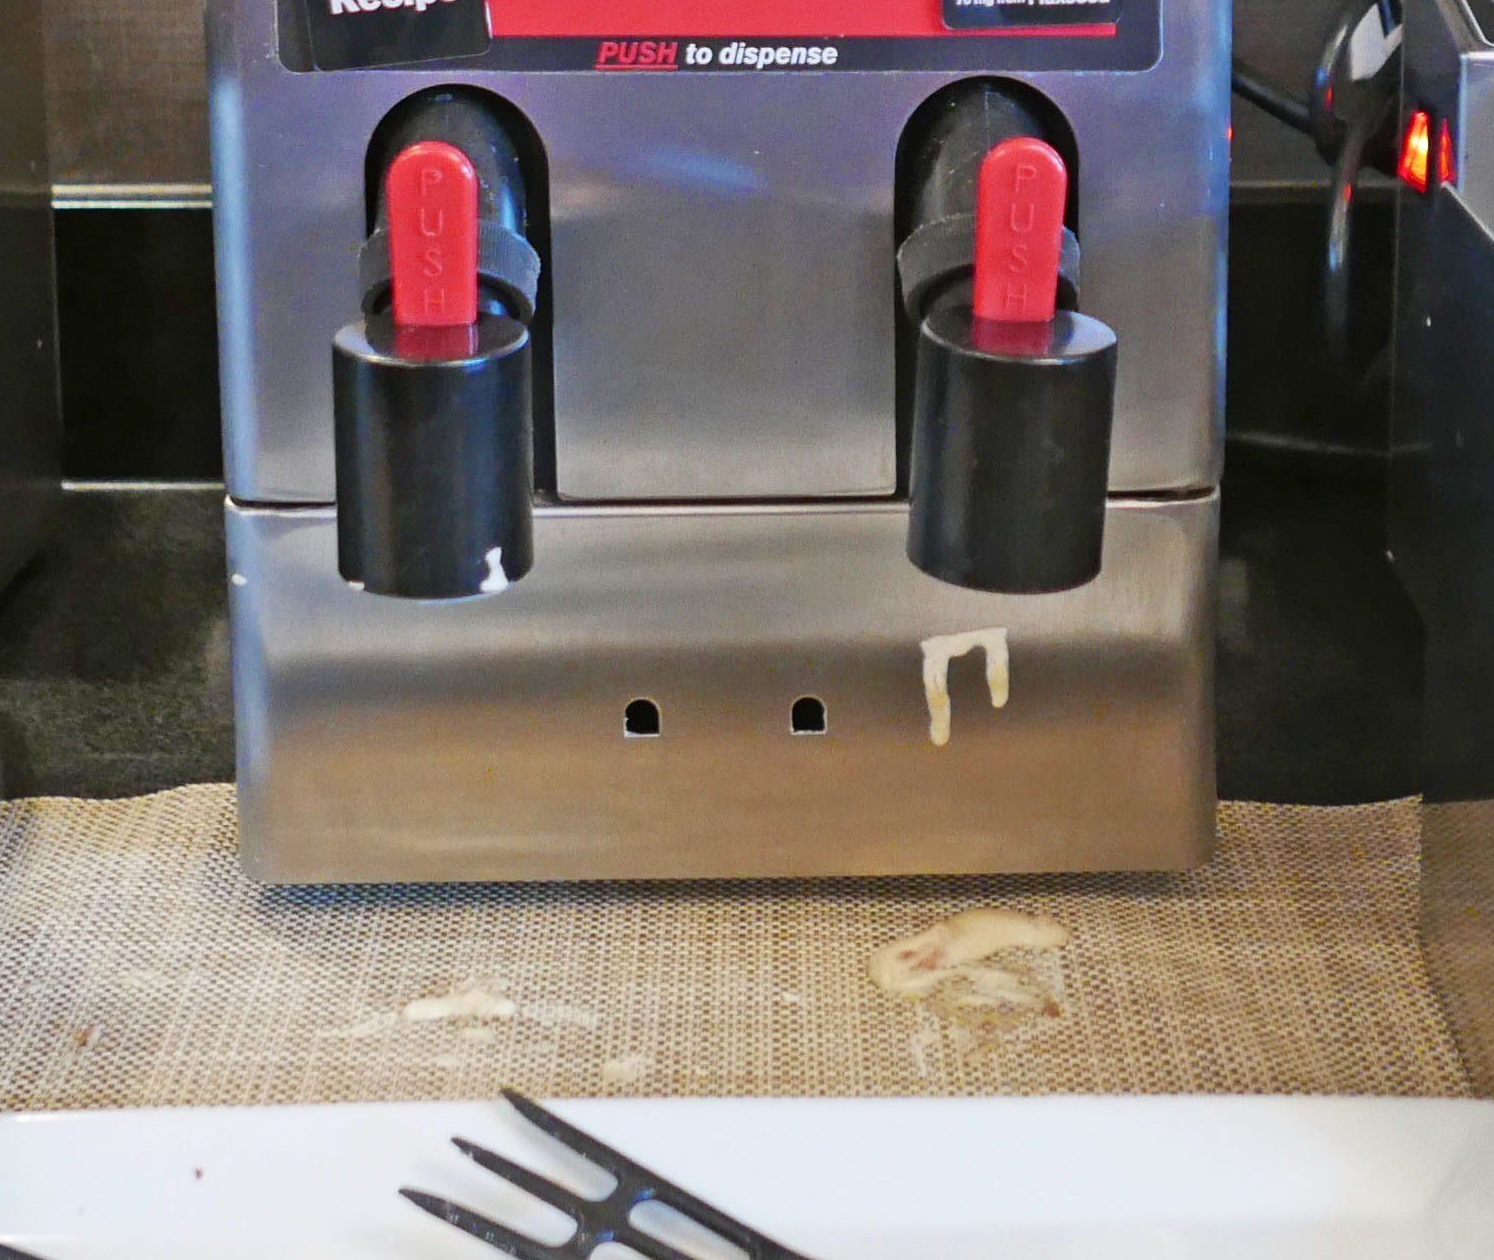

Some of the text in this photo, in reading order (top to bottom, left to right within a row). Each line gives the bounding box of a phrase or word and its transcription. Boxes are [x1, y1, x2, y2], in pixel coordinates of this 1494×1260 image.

[597, 41, 839, 69] PUSH to dispense
[417, 167, 446, 316] PUSH
[1002, 163, 1037, 311] PUSH
